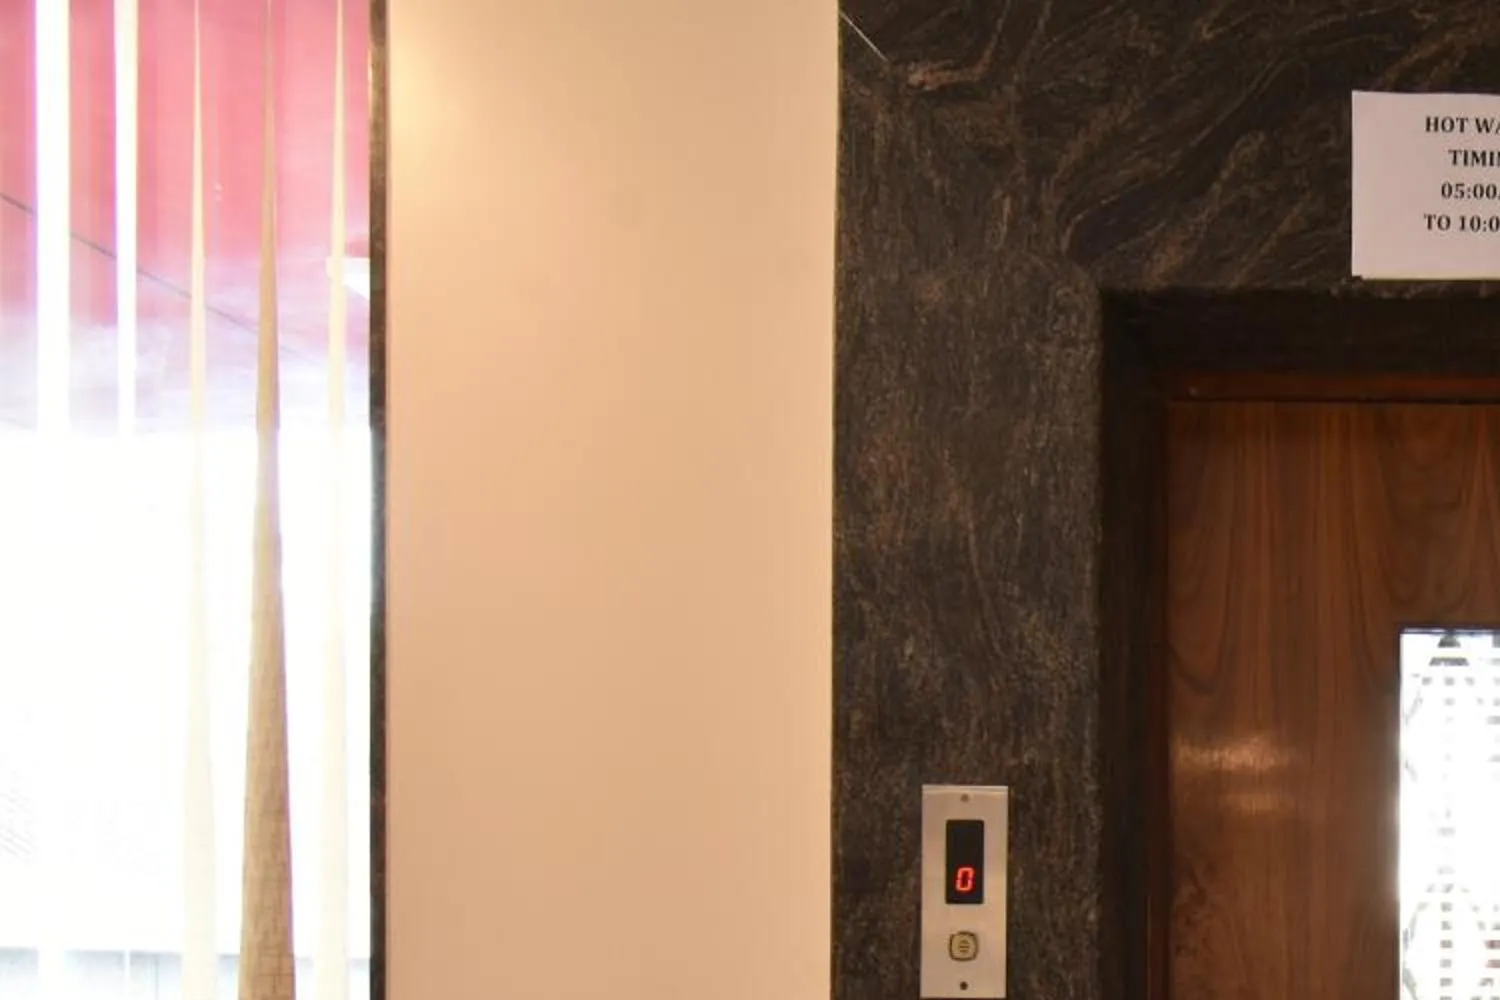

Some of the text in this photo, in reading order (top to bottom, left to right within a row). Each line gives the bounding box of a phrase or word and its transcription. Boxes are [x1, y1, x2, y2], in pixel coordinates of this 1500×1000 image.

[1425, 115, 1469, 133] HOT
[1423, 214, 1452, 232] TO
[955, 866, 976, 892] 0
